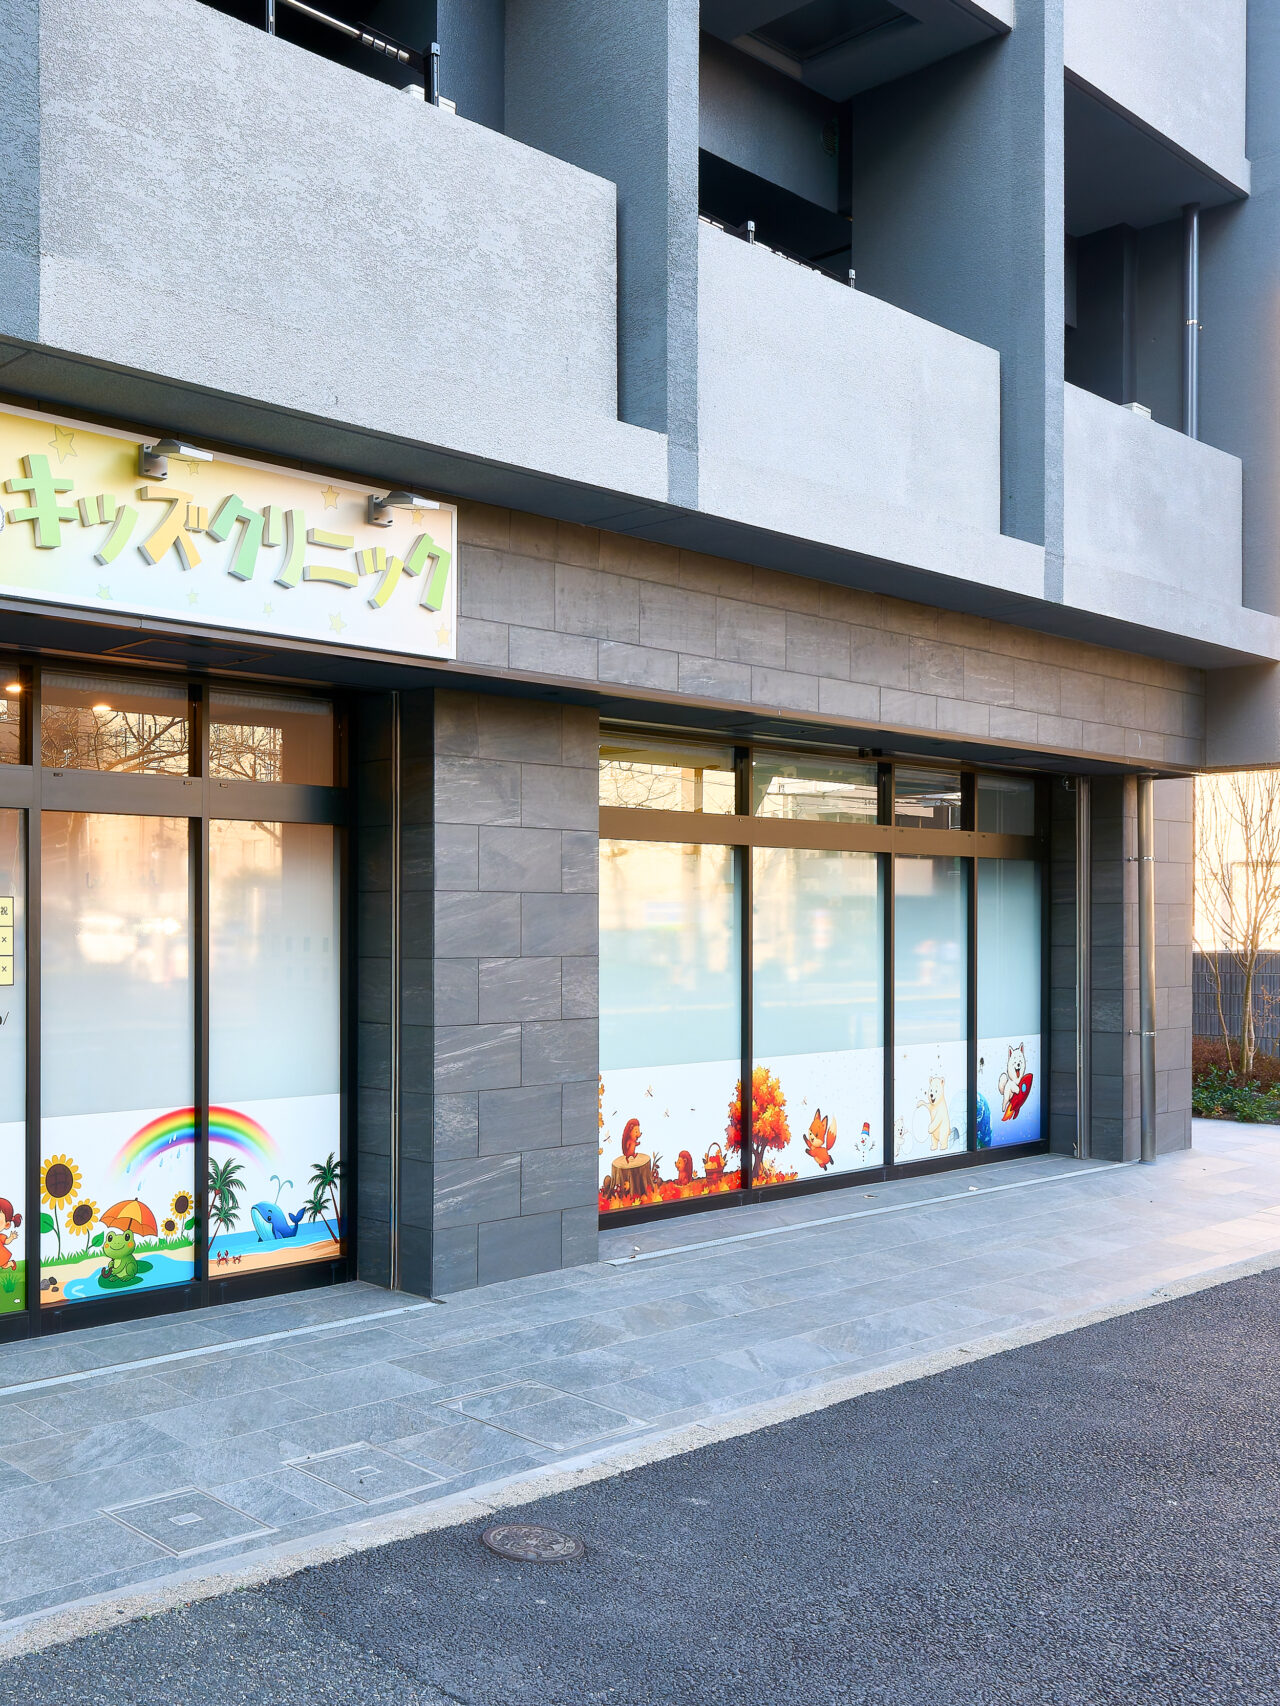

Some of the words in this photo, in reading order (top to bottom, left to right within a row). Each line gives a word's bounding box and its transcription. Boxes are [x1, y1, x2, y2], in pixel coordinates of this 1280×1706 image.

[4, 453, 451, 612] キッズクリニック
[0, 906, 9, 916] 祝
